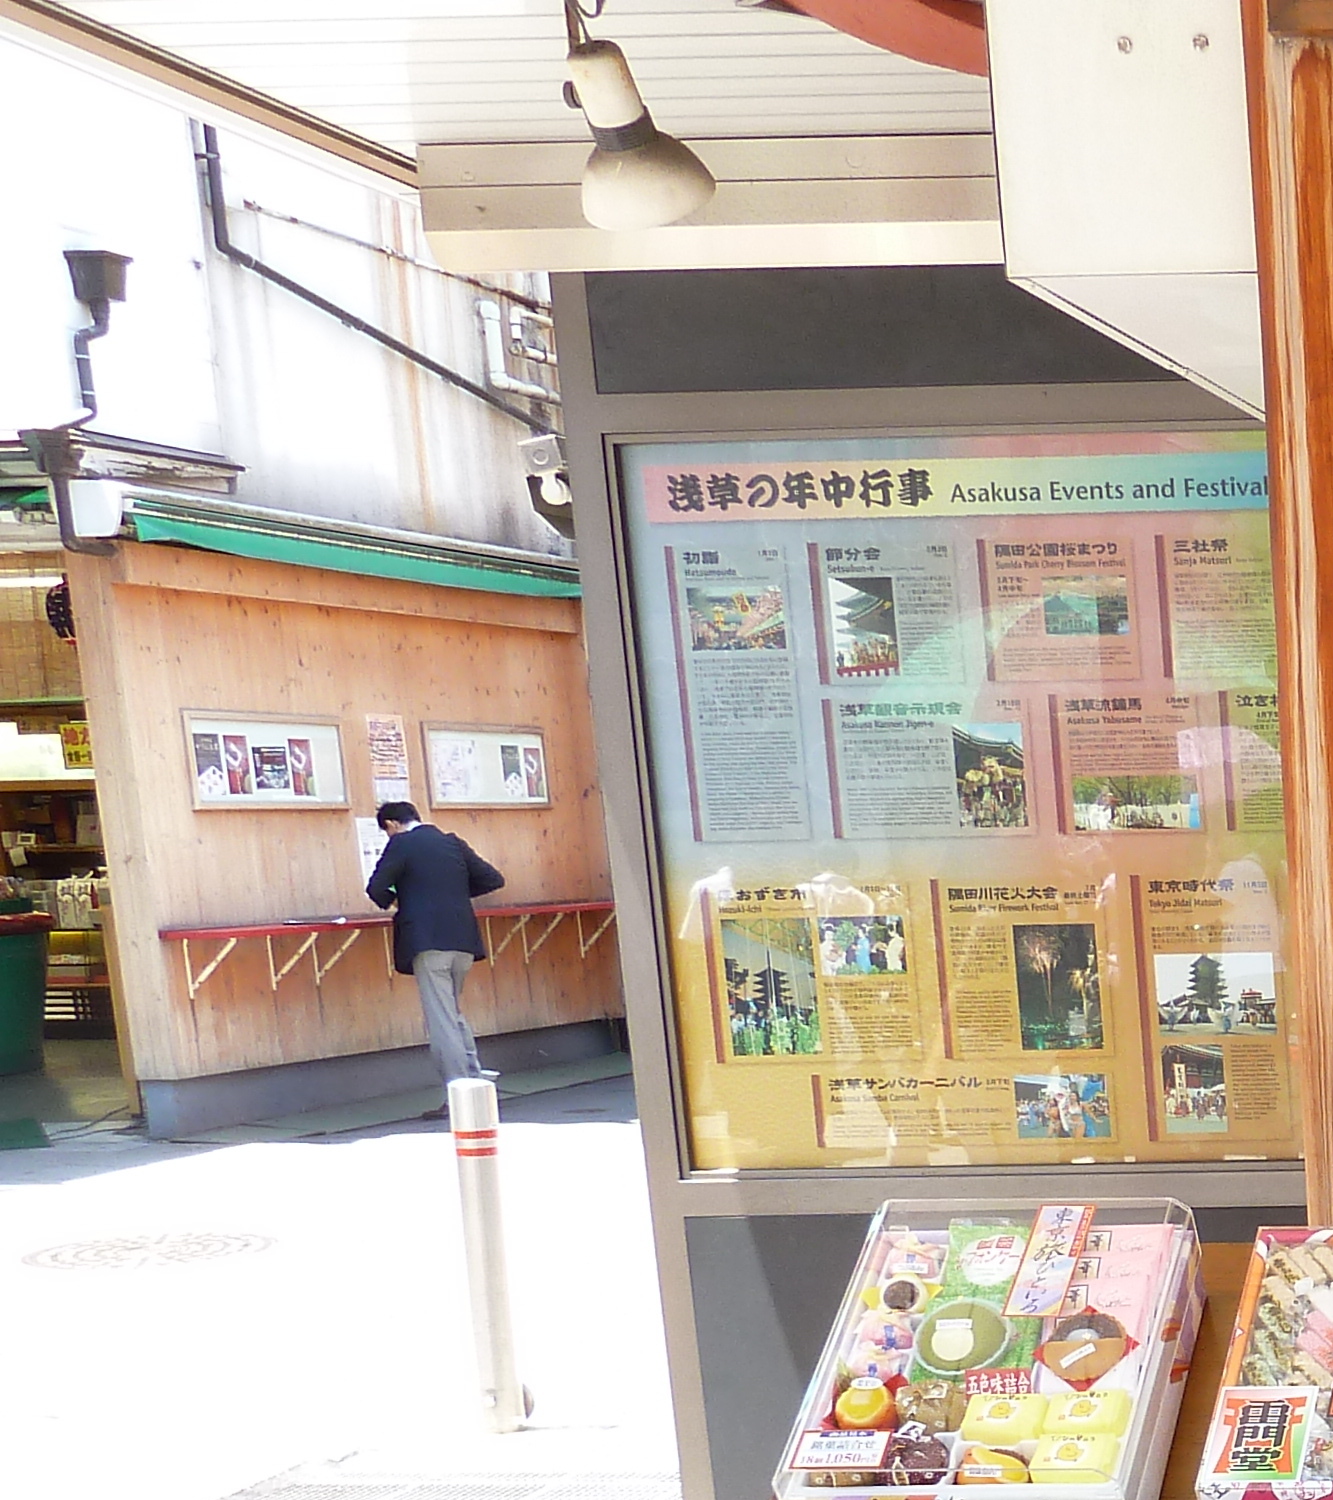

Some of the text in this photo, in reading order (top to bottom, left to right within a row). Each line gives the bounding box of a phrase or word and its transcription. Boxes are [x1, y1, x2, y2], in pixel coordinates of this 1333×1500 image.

[666, 468, 934, 512] 浅草の年中行事
[951, 481, 1041, 503] Asakusa
[1050, 481, 1124, 501] Events
[1132, 478, 1175, 499] and
[994, 542, 1118, 558] 隅田公園桜まつり
[1174, 539, 1229, 553] 三社祭
[825, 547, 881, 562] 節分会
[948, 886, 1058, 901] 隅田川花火大会
[1149, 879, 1234, 893] 東京時代祭
[829, 1077, 981, 1090] 浅草サンバカーニバル
[966, 1371, 1031, 1395] 五色味詰合
[1230, 1398, 1290, 1473] 雷門堂
